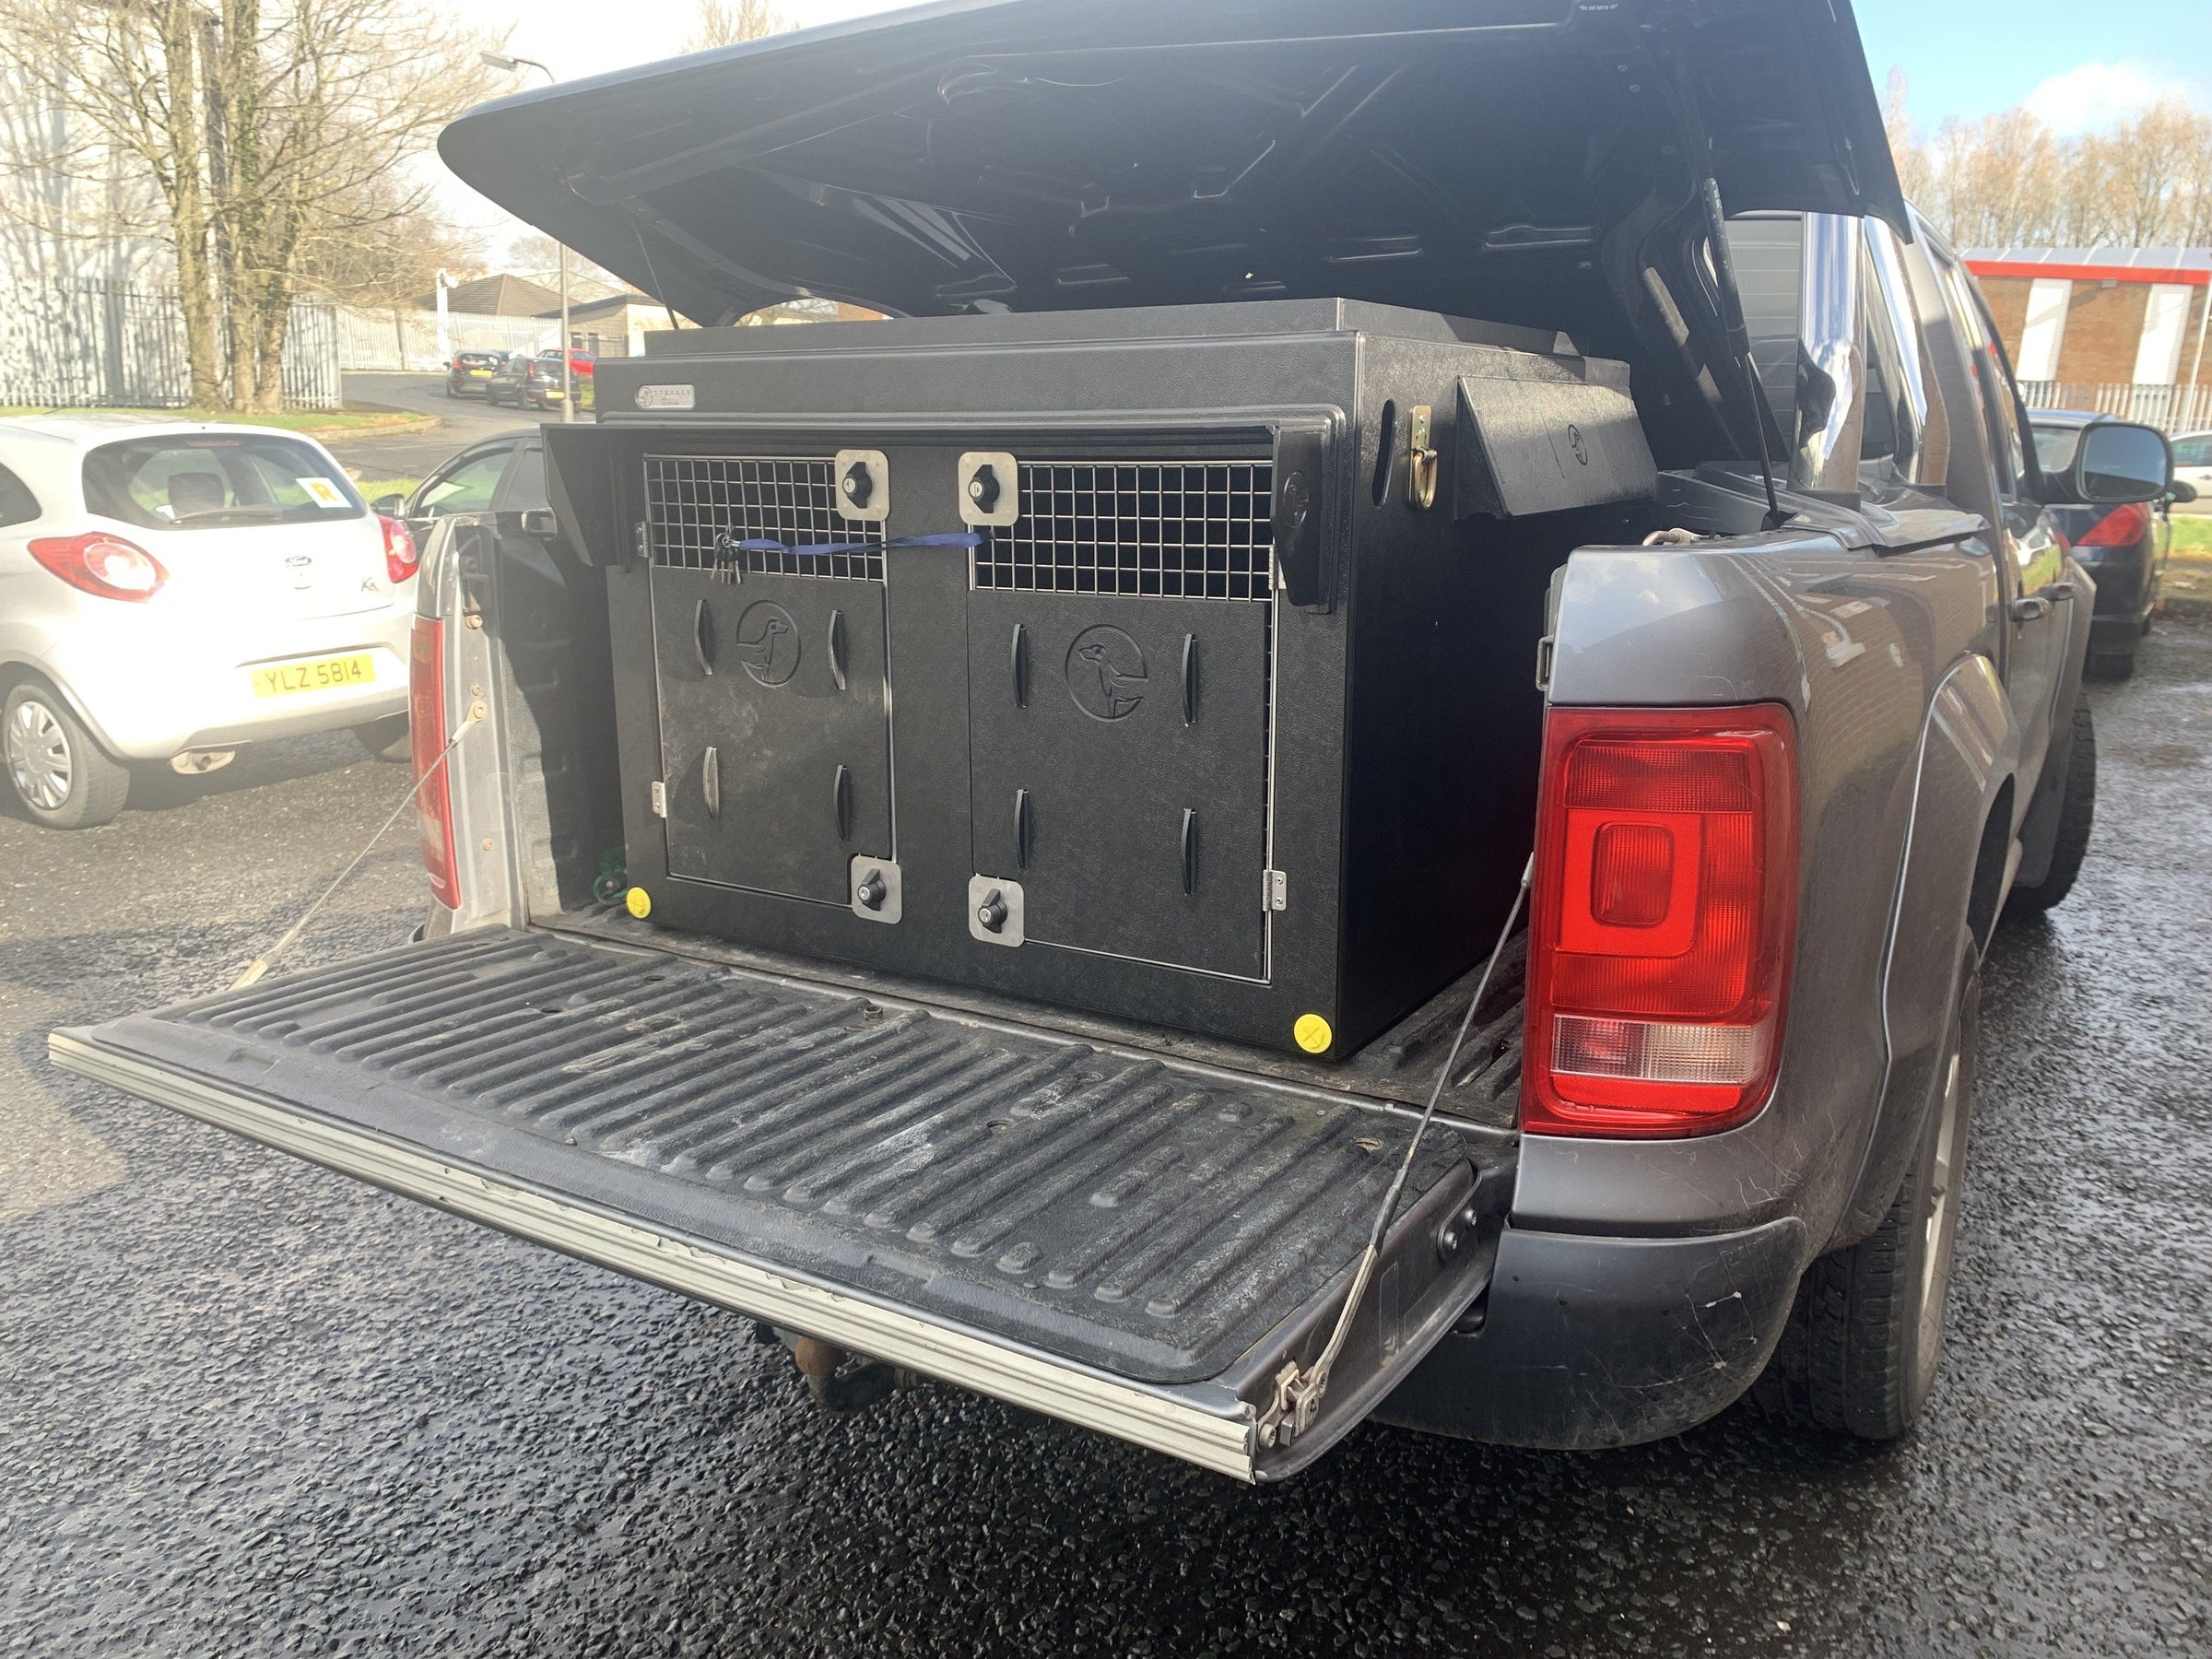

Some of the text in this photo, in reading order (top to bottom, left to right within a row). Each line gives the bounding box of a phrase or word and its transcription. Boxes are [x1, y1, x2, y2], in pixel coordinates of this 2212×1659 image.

[360, 576, 380, 592] Ka
[265, 660, 361, 692] YLZ 5814
